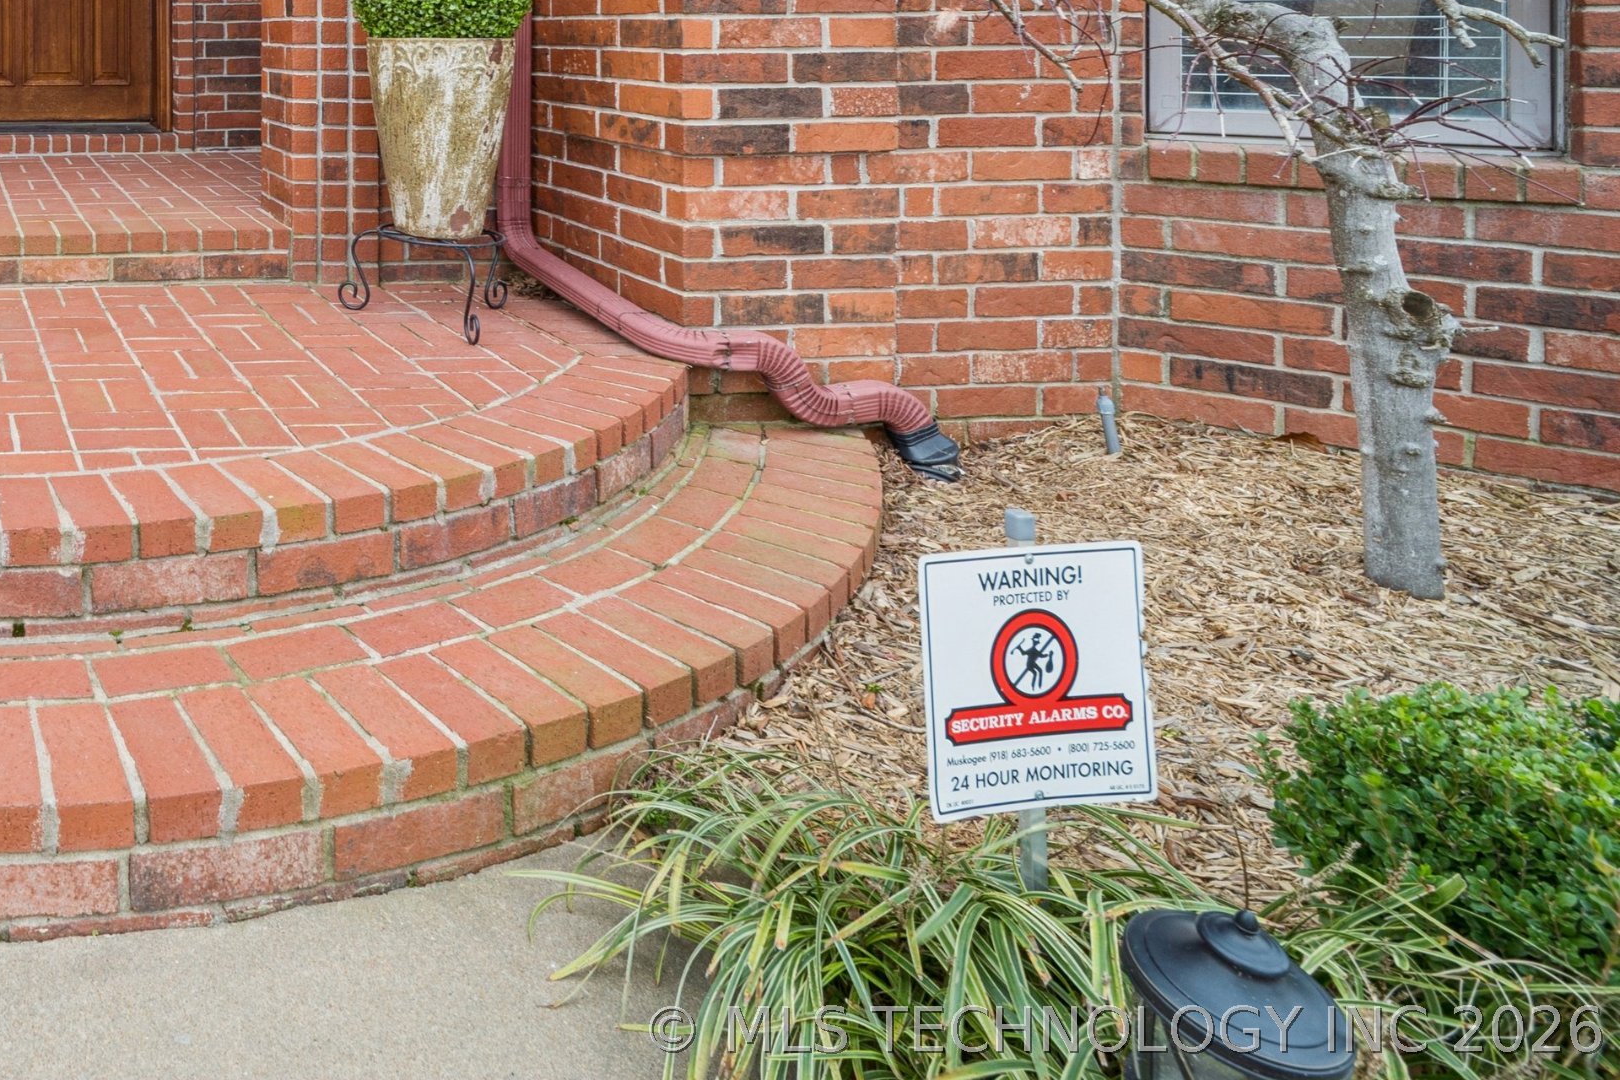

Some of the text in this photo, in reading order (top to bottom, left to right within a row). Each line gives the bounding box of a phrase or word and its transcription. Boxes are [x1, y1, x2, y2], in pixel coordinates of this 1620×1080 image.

[978, 565, 1083, 592] WARNING!
[993, 589, 1070, 606] PROTECTED BY
[951, 712, 1025, 734] SECURITY
[1028, 706, 1098, 723] ALARMS
[946, 740, 1135, 767] Muskogee (918) 683-5600 (800) 725-5600
[951, 760, 1134, 792] 24 HOUR MONITORING
